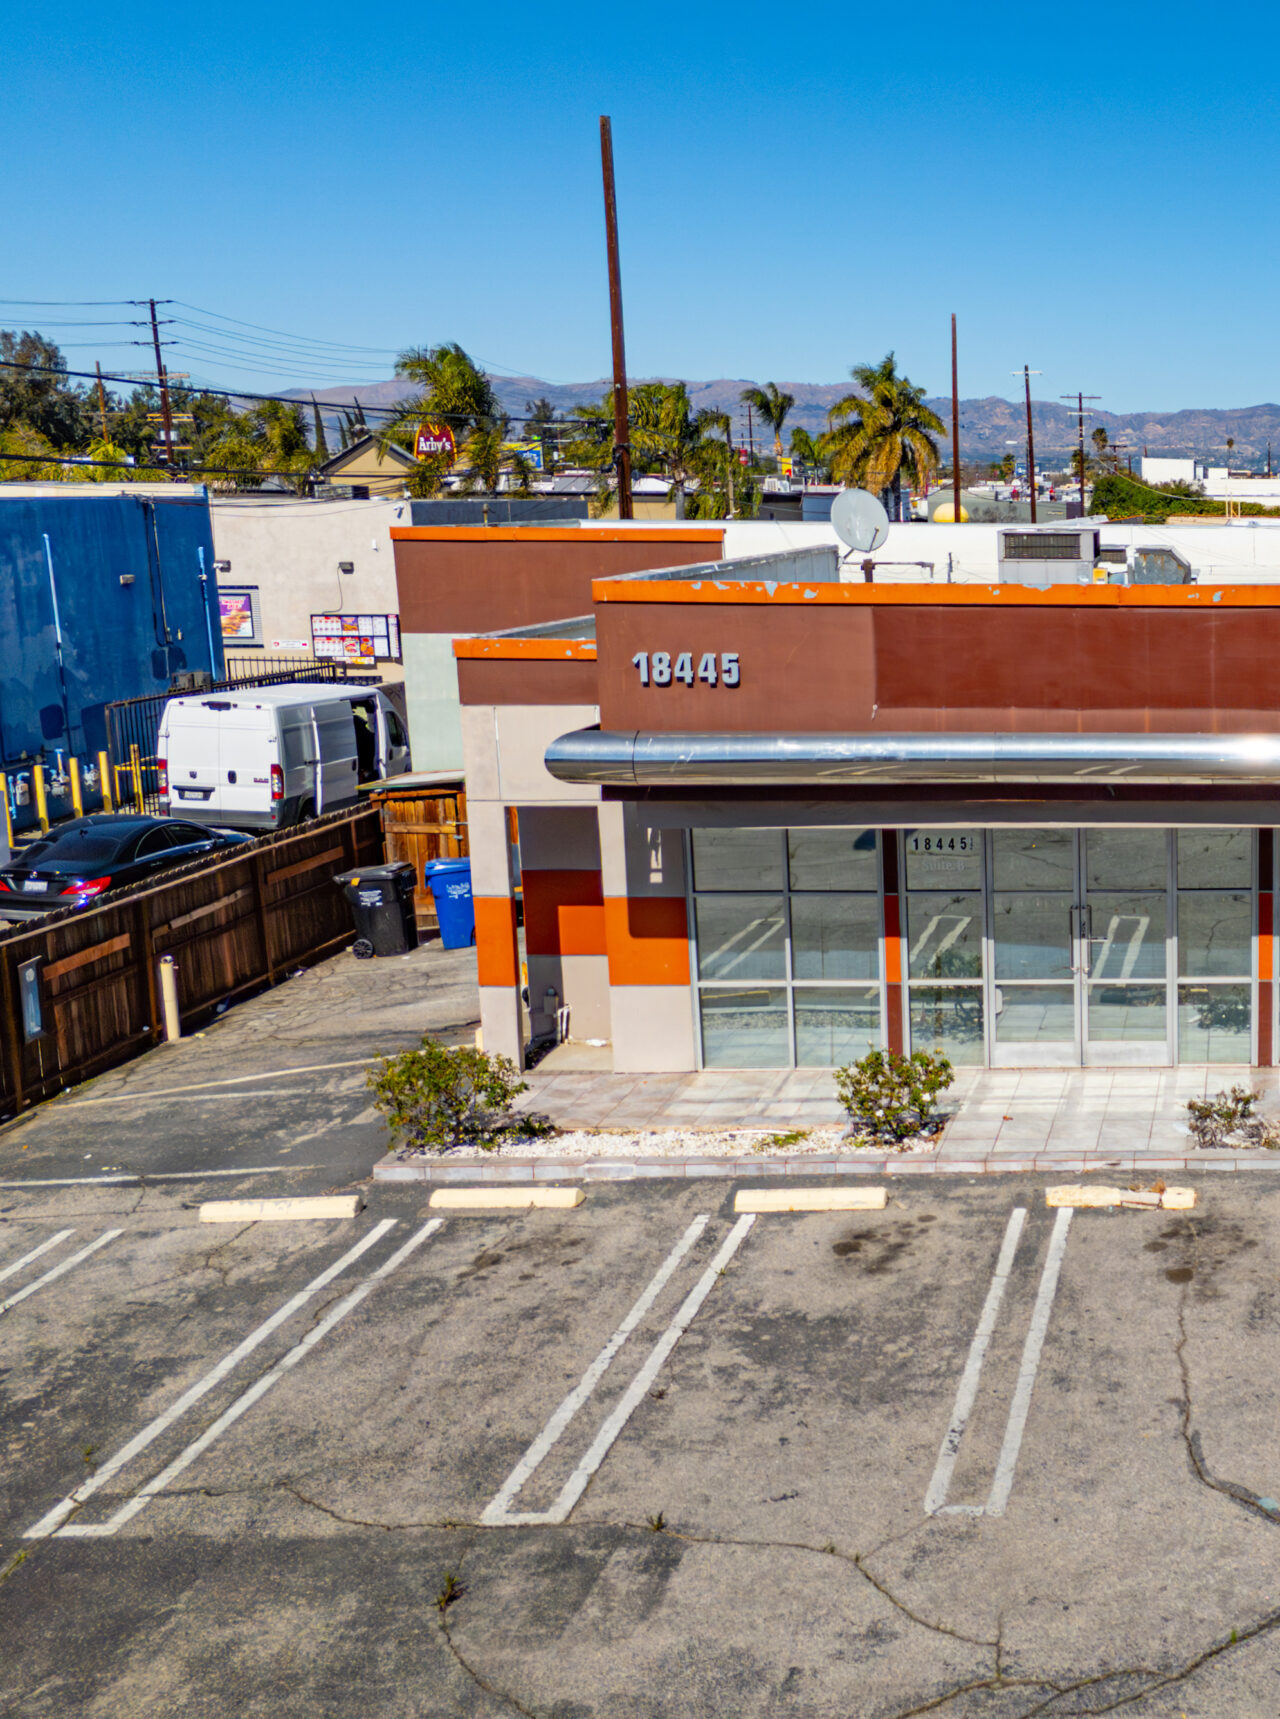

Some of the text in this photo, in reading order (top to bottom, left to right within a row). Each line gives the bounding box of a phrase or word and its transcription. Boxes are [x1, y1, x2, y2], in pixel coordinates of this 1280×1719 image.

[419, 437, 451, 453] Arby's
[632, 651, 739, 686] 18445
[913, 836, 967, 850] 18445
